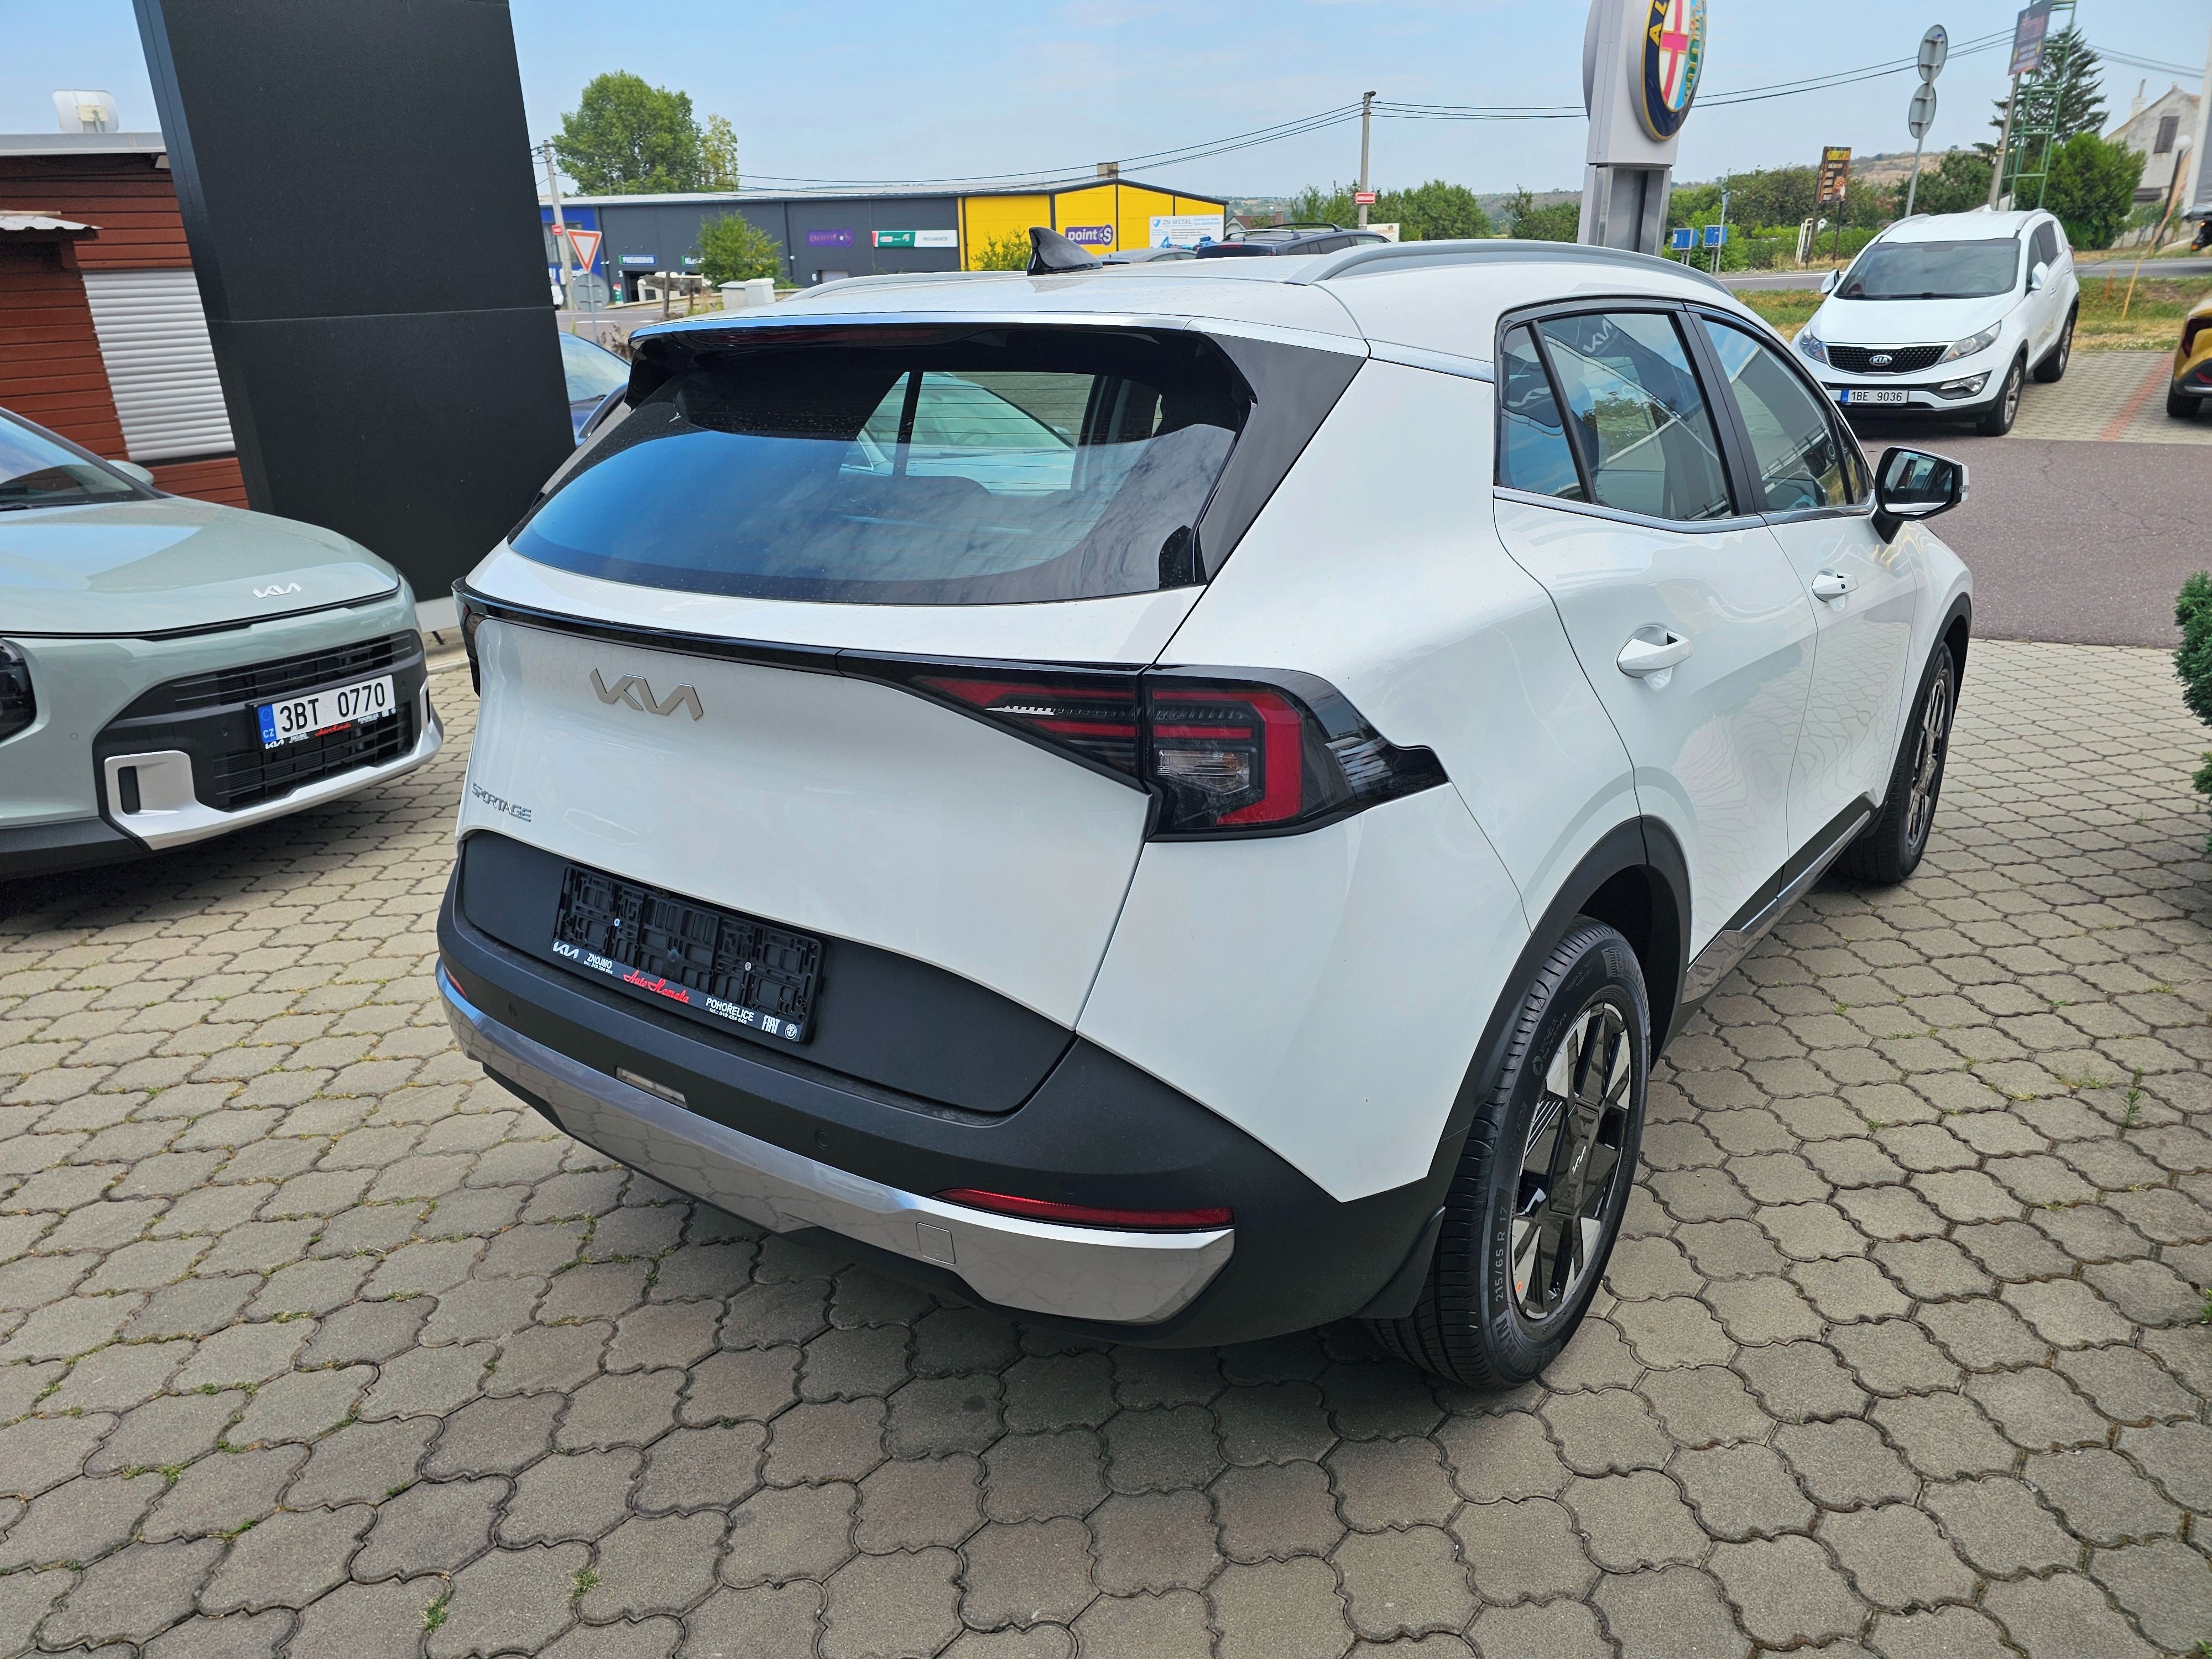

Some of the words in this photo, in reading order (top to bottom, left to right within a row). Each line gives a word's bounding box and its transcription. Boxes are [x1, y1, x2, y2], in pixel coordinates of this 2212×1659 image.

[1068, 228, 1098, 241] point
[1851, 392, 1870, 401] 1BE
[1877, 392, 1903, 401] 9036
[253, 582, 302, 599] KIA
[589, 667, 703, 722] KIA
[279, 698, 319, 733] 3BT
[337, 682, 385, 718] 0770
[263, 728, 275, 738] CZ
[472, 782, 531, 822] SPORTAGE
[552, 941, 580, 959] KIA
[587, 953, 612, 968] ZNOJMO
[706, 997, 754, 1021] POHOŘELICE
[761, 1014, 781, 1034] FIAT
[1499, 1206, 1509, 1223] 17
[1496, 1230, 1505, 1241] R
[1495, 1248, 1505, 1303] 215/65
